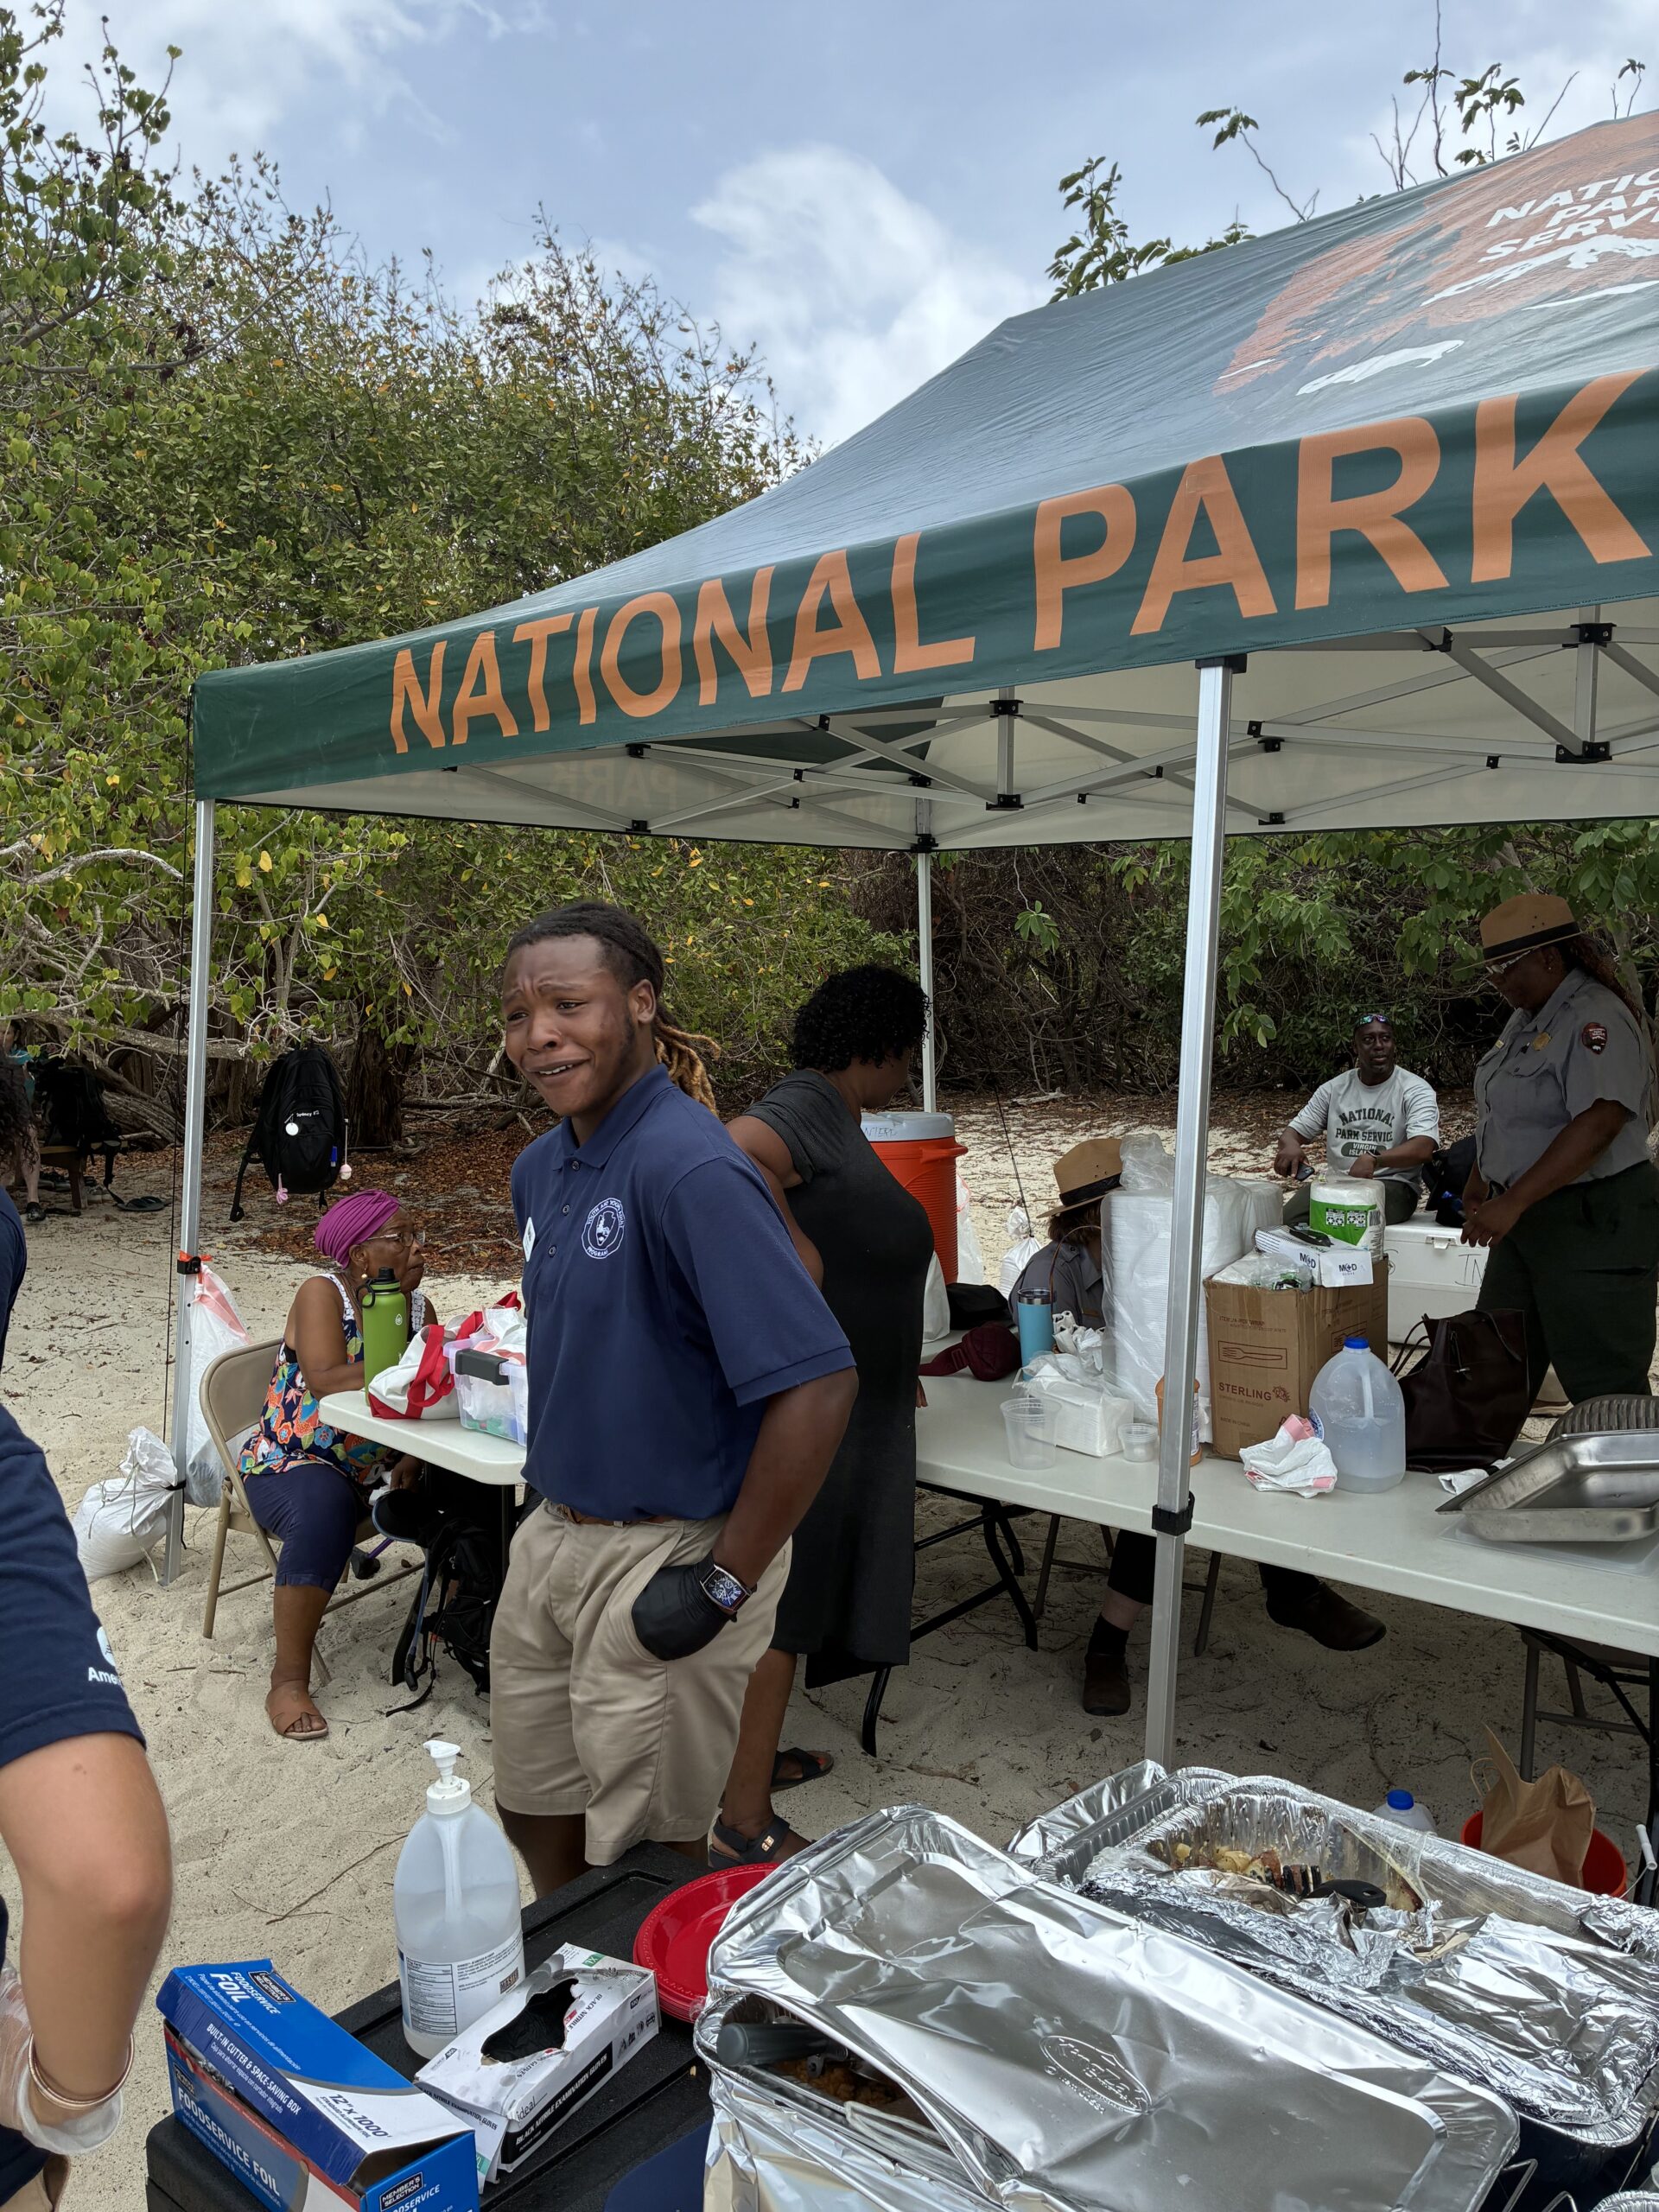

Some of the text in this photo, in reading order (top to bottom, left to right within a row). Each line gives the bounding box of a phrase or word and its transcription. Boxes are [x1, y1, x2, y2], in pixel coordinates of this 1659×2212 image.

[390, 367, 1654, 753] NATIONAL PARK
[1335, 1128, 1360, 1141] PARK
[1352, 1142, 1377, 1151] VIRGIN
[1218, 1382, 1272, 1401] STERLING
[88, 1667, 121, 1685] Ame
[584, 1955, 598, 1966] XL
[210, 1973, 251, 2003] FOIL
[231, 1972, 281, 2014] FOODSERVICE
[254, 1974, 283, 2002] SELECTION
[586, 1993, 603, 2011] BLACK
[568, 2009, 588, 2030] NITRILE
[211, 2042, 219, 2052] Caja
[207, 2024, 230, 2048] BUILT-IN
[227, 2043, 249, 2066] CUTTER
[246, 2061, 253, 2069] &
[251, 2065, 290, 2103] SPACE-SAVING
[287, 2099, 302, 2115] BOX
[516, 2126, 535, 2145] BLACK
[535, 2104, 556, 2126] NITRILE
[554, 2071, 590, 2110] EXAMINATION
[589, 2053, 607, 2075] GLOVES
[516, 2093, 548, 2120] ideal
[482, 2117, 499, 2131] GLOVES
[178, 2087, 251, 2168] FOODSERVICE
[253, 2160, 280, 2196] FOIL
[382, 2176, 421, 2202] MEMBER'S
[385, 2183, 420, 2207] SELECTION
